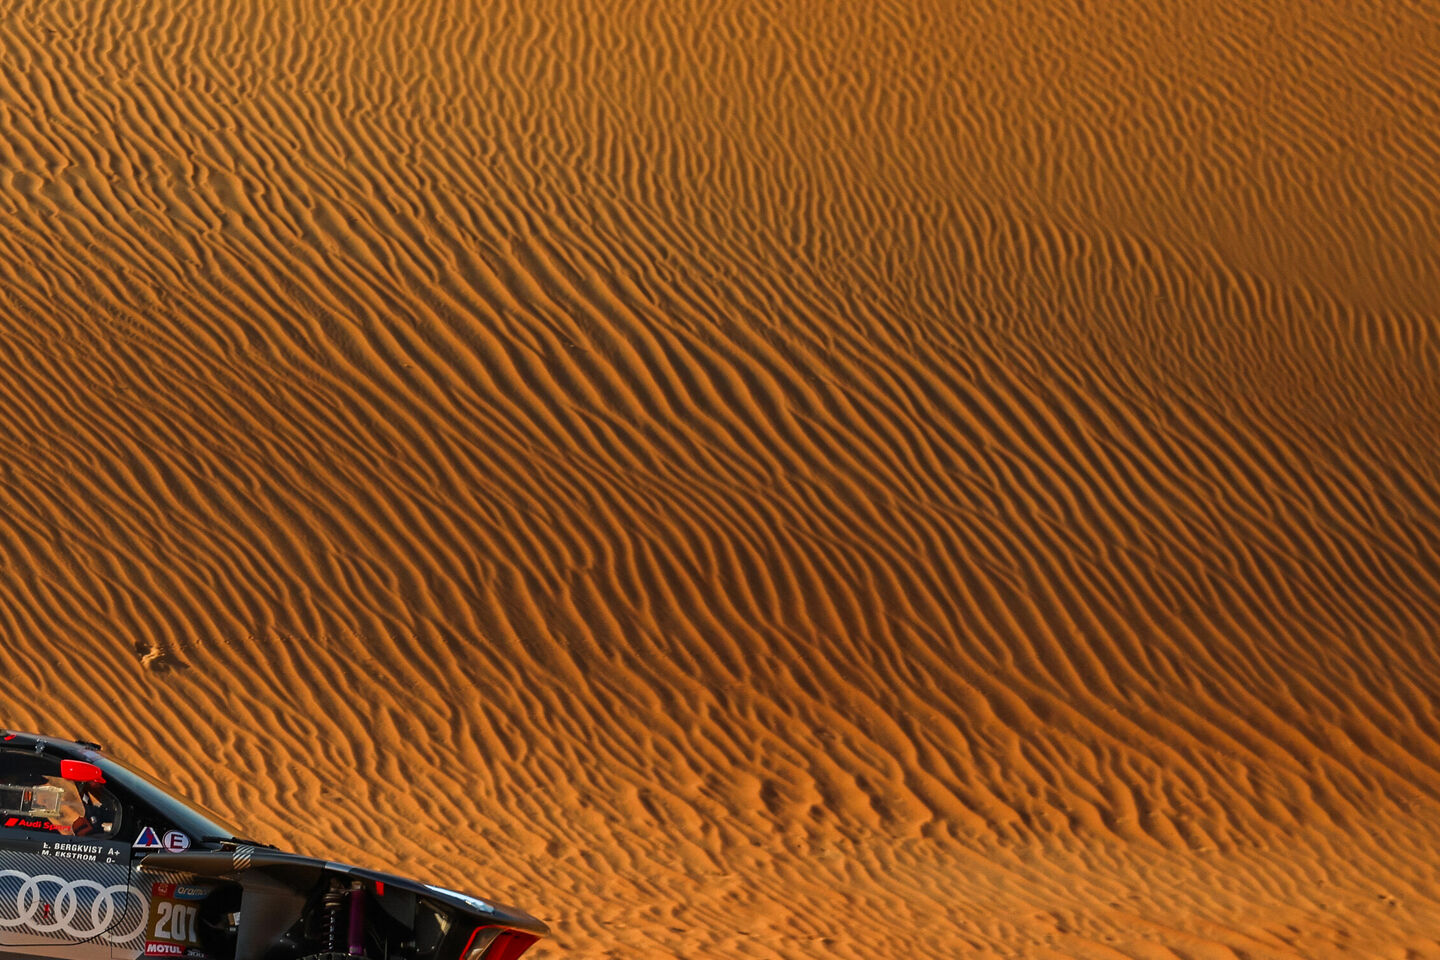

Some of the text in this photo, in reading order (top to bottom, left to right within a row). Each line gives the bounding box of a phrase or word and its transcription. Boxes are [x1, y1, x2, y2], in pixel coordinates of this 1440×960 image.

[19, 819, 42, 828] Audi
[170, 833, 183, 849] E
[54, 842, 103, 854] BERGKVIST
[108, 848, 120, 856] A+
[154, 901, 198, 943] 201
[146, 943, 182, 954] MOTUL
